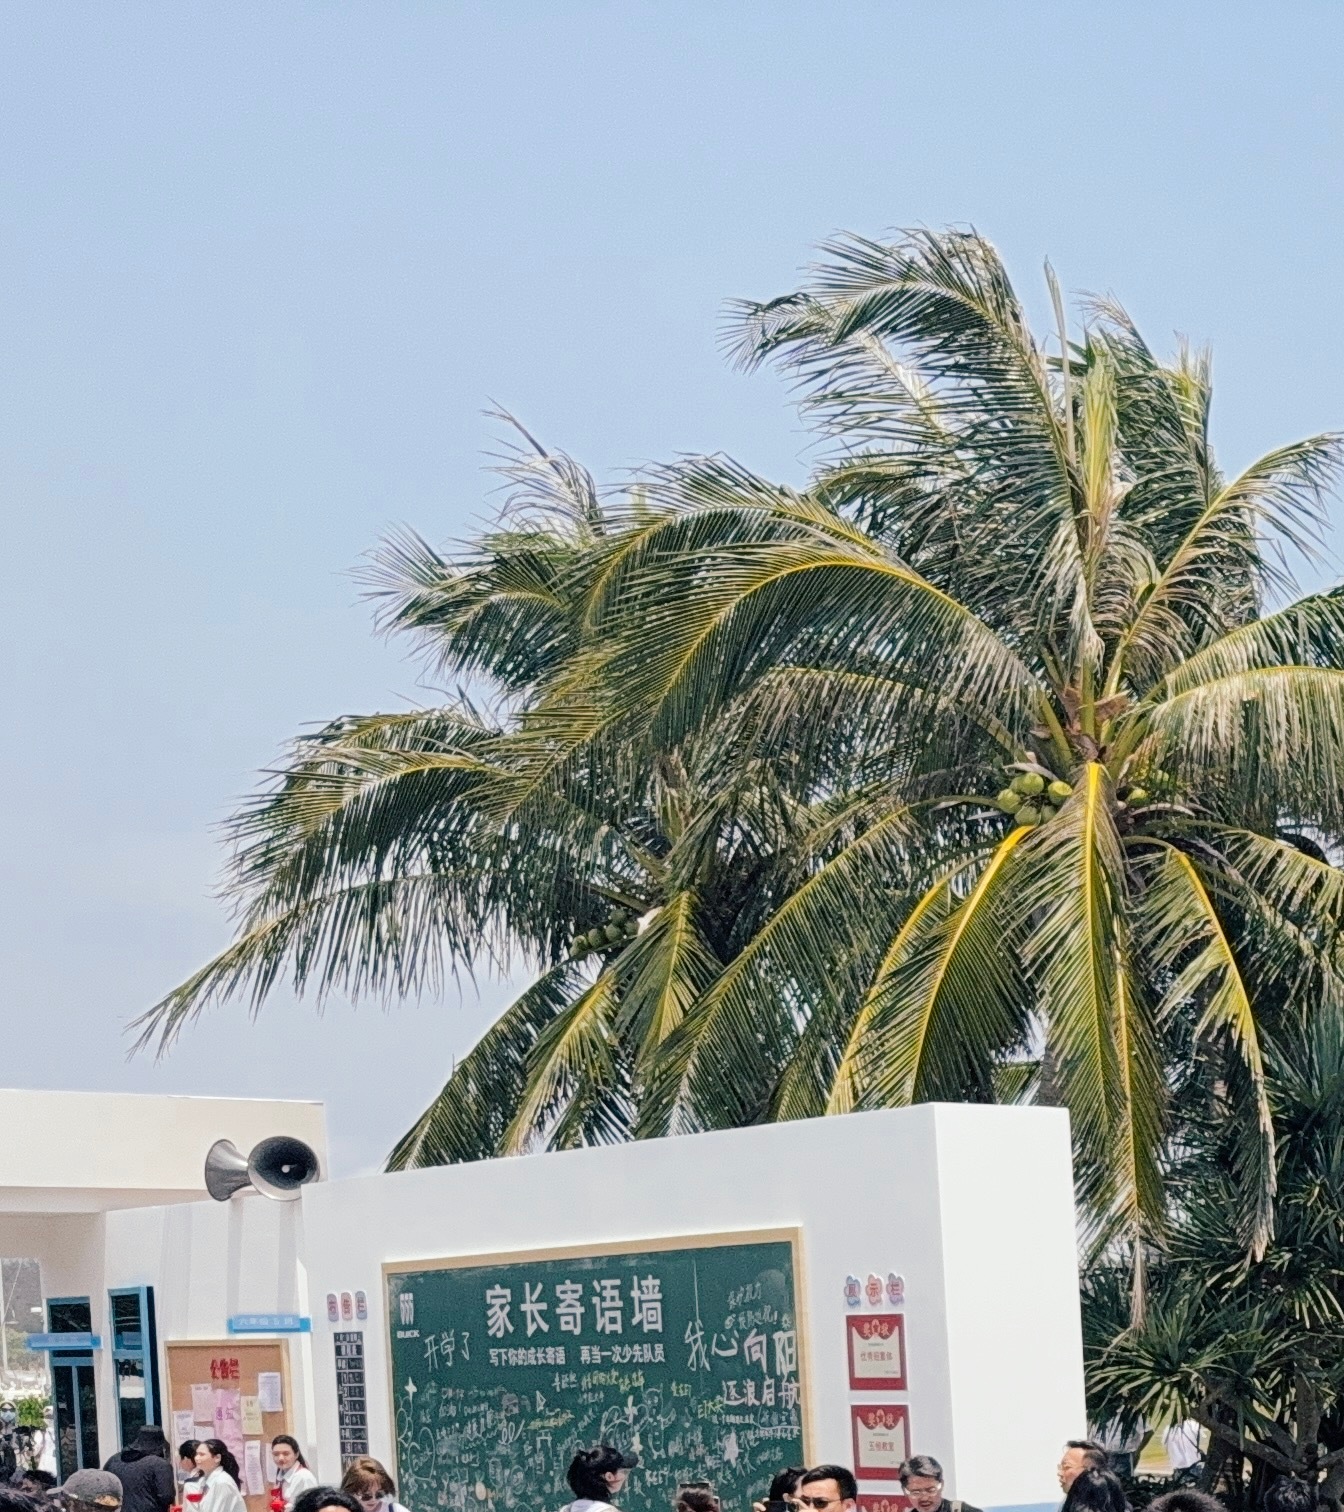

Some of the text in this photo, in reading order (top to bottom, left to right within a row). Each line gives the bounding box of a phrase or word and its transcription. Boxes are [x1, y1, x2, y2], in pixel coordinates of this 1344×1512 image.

[485, 1274, 663, 1338] 家长寄语墙
[424, 1329, 470, 1372] 开学了
[489, 1343, 665, 1367] 写下你的成长寄语 再当一次少先队员
[685, 1319, 798, 1376] 我心向阳
